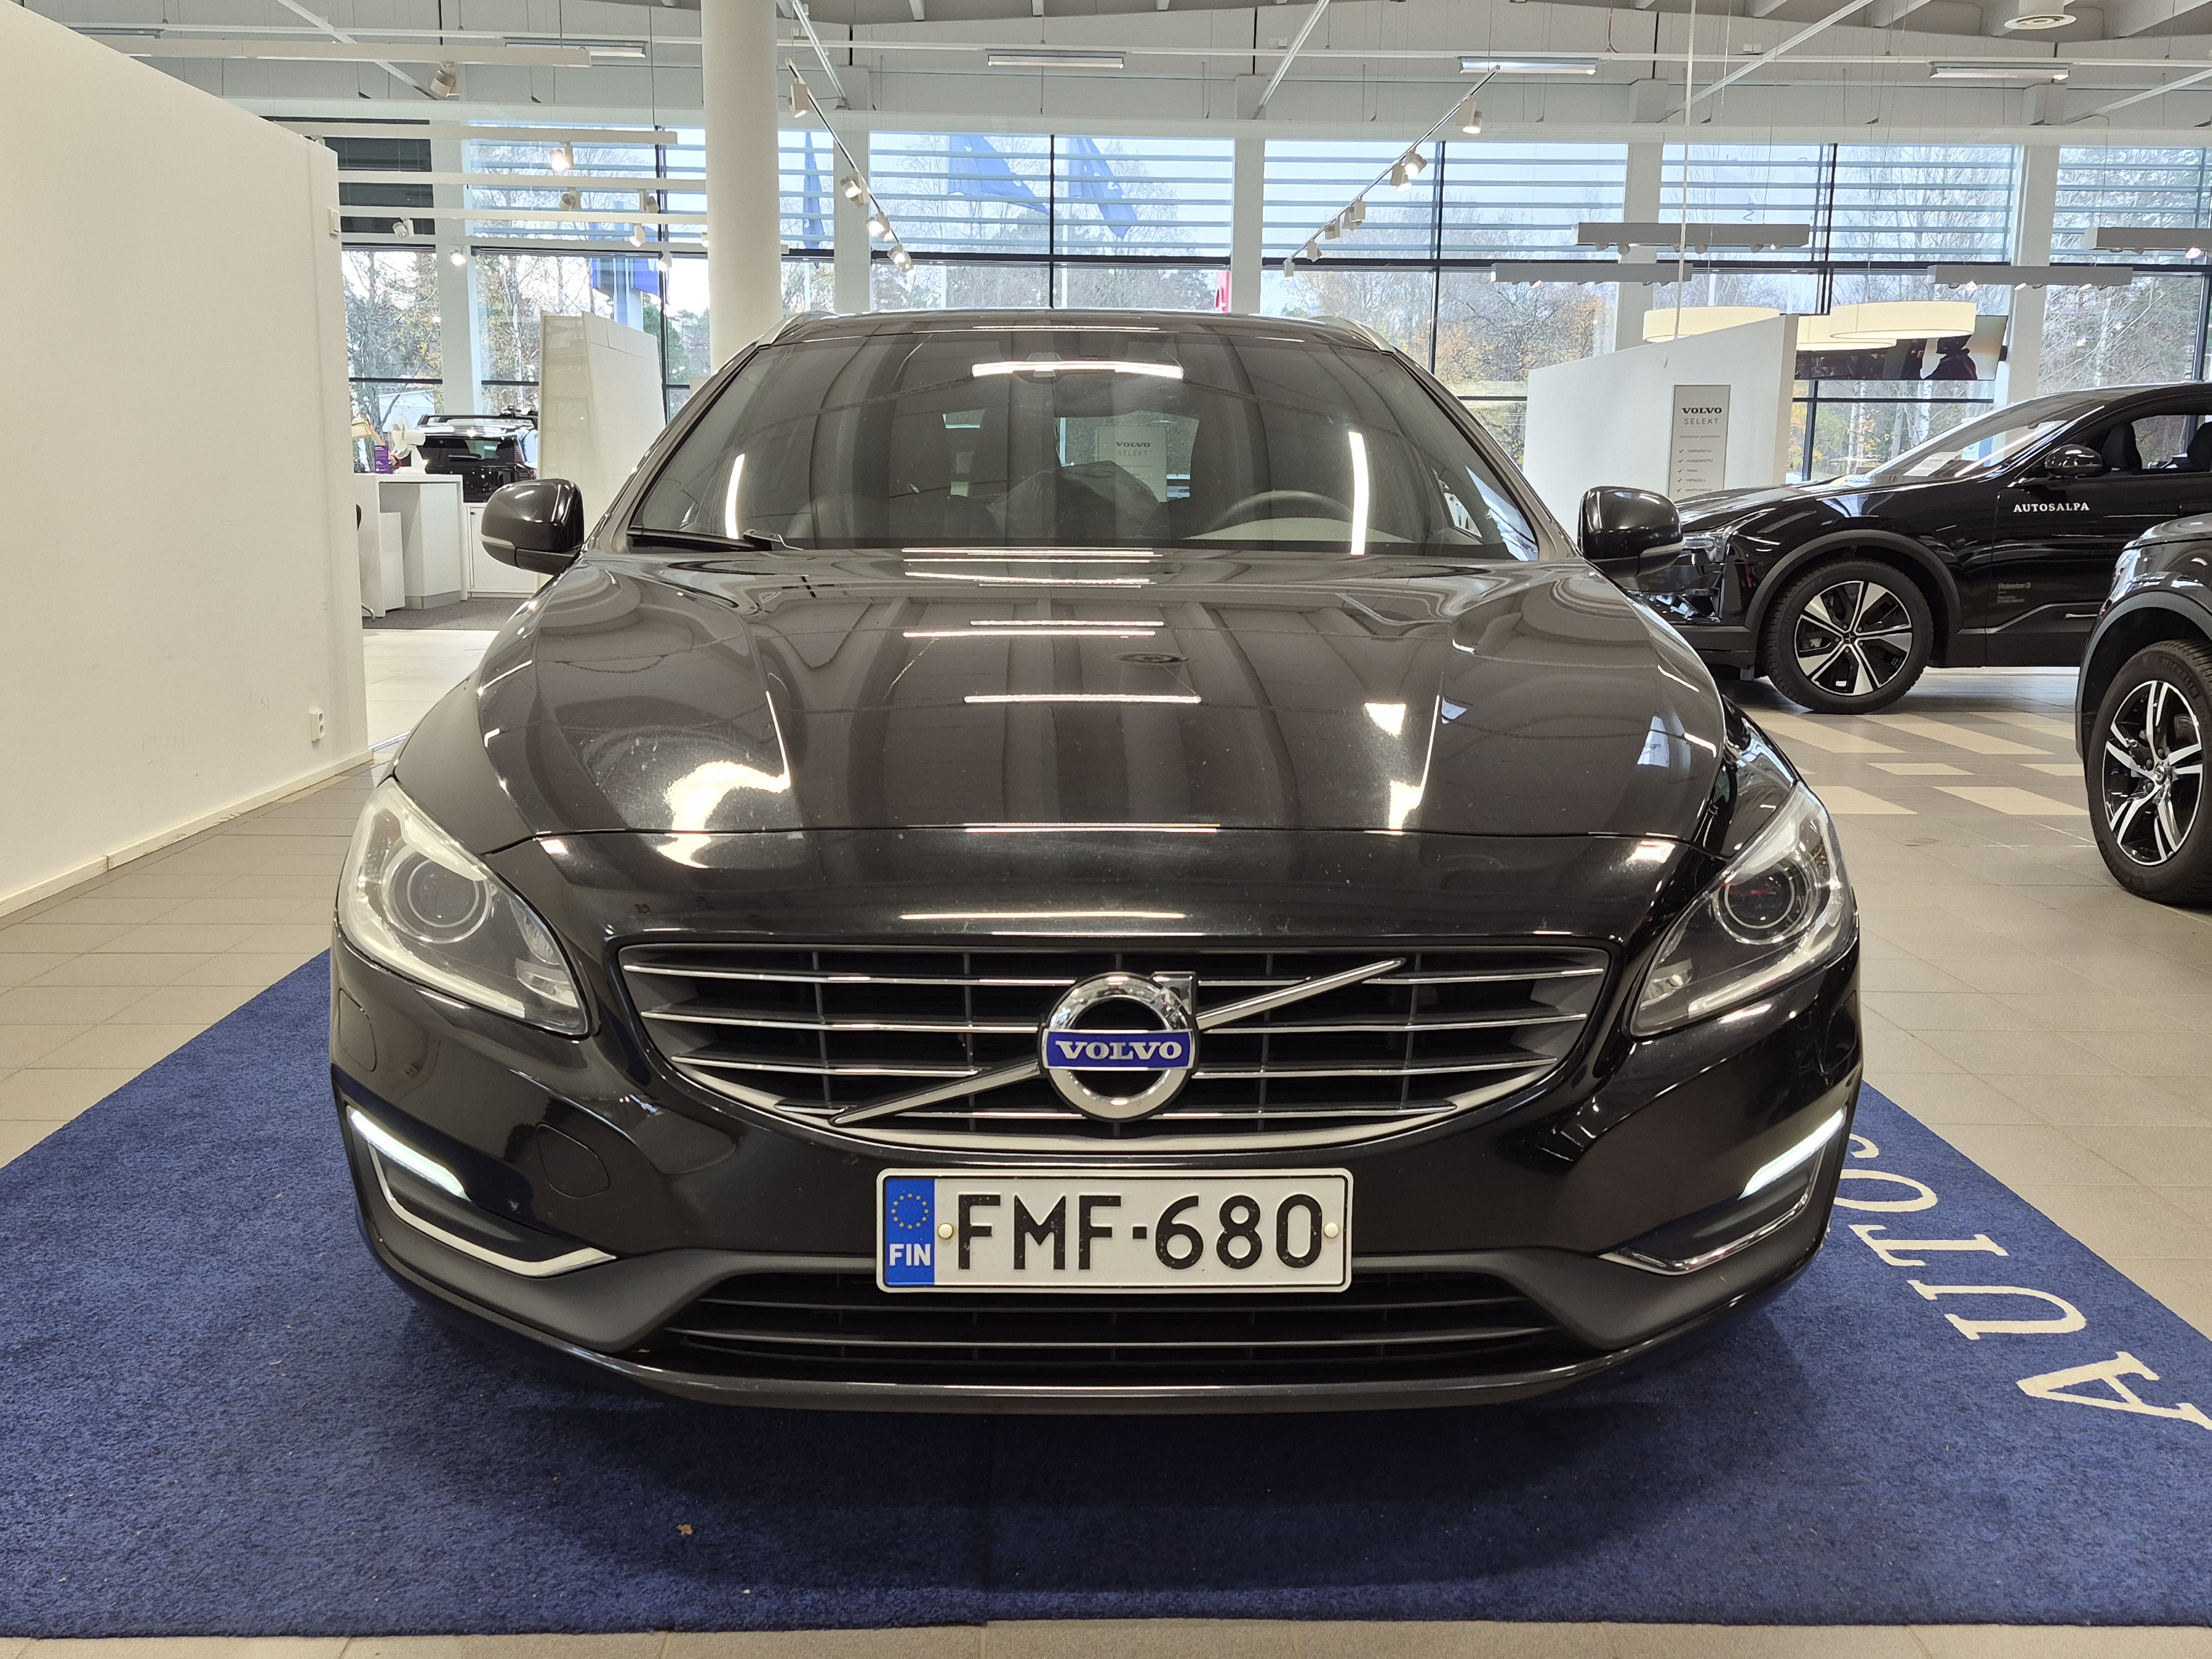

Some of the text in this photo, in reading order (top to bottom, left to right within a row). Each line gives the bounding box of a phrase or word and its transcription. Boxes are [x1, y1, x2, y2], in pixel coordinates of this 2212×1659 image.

[2013, 502, 2090, 513] AUTOSALPA
[1055, 1040, 1182, 1061] VOLVO
[889, 1193, 1323, 1271] FIN FMF-680
